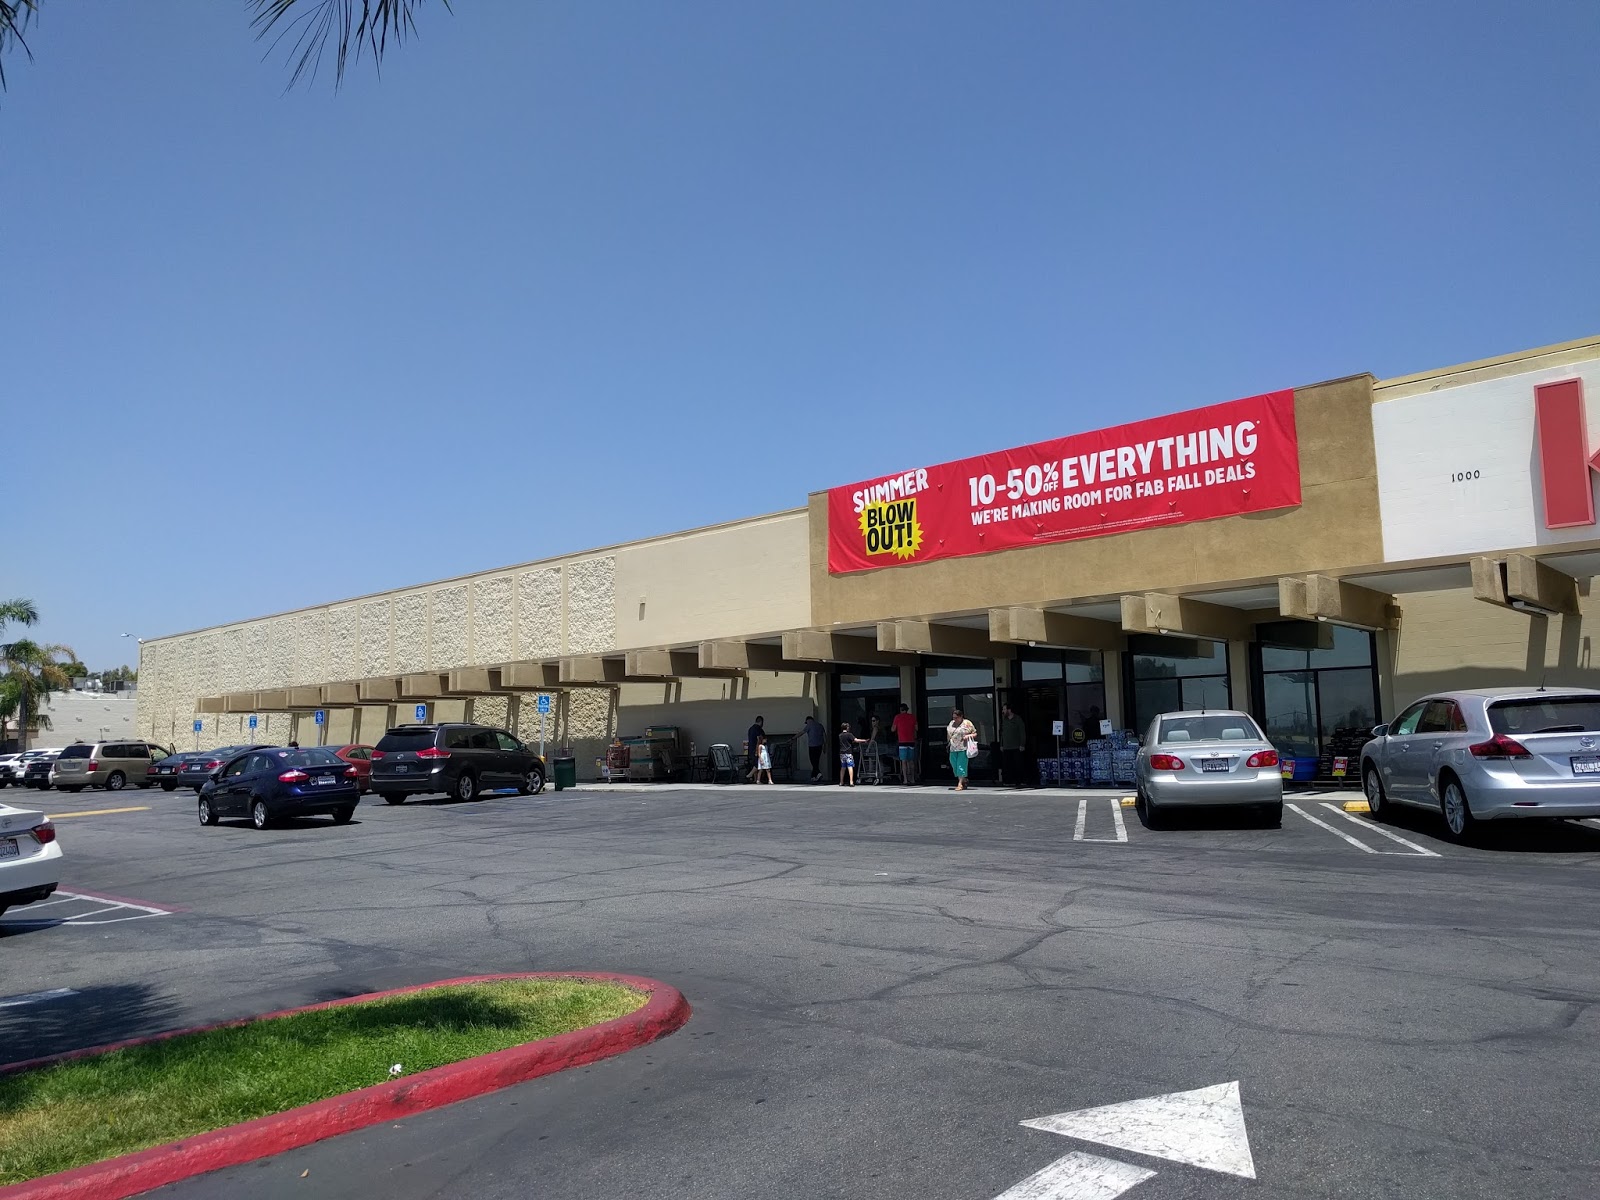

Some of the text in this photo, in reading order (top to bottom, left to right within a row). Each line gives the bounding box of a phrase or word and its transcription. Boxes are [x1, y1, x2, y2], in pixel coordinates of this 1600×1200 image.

[852, 468, 929, 513] SUMMER
[969, 461, 1059, 507] 10-50%
[1043, 481, 1059, 493] OFF
[971, 507, 1009, 526] WE'RE
[1012, 497, 1061, 519] MAKING
[1064, 490, 1102, 511] ROOM
[1105, 484, 1133, 503] FOR
[1135, 479, 1164, 498] FAB
[1167, 472, 1202, 493] FALL
[1204, 462, 1256, 486] DEALS
[1451, 469, 1481, 483] 1000
[867, 501, 914, 528] BLOW
[867, 522, 913, 552] OUT!
